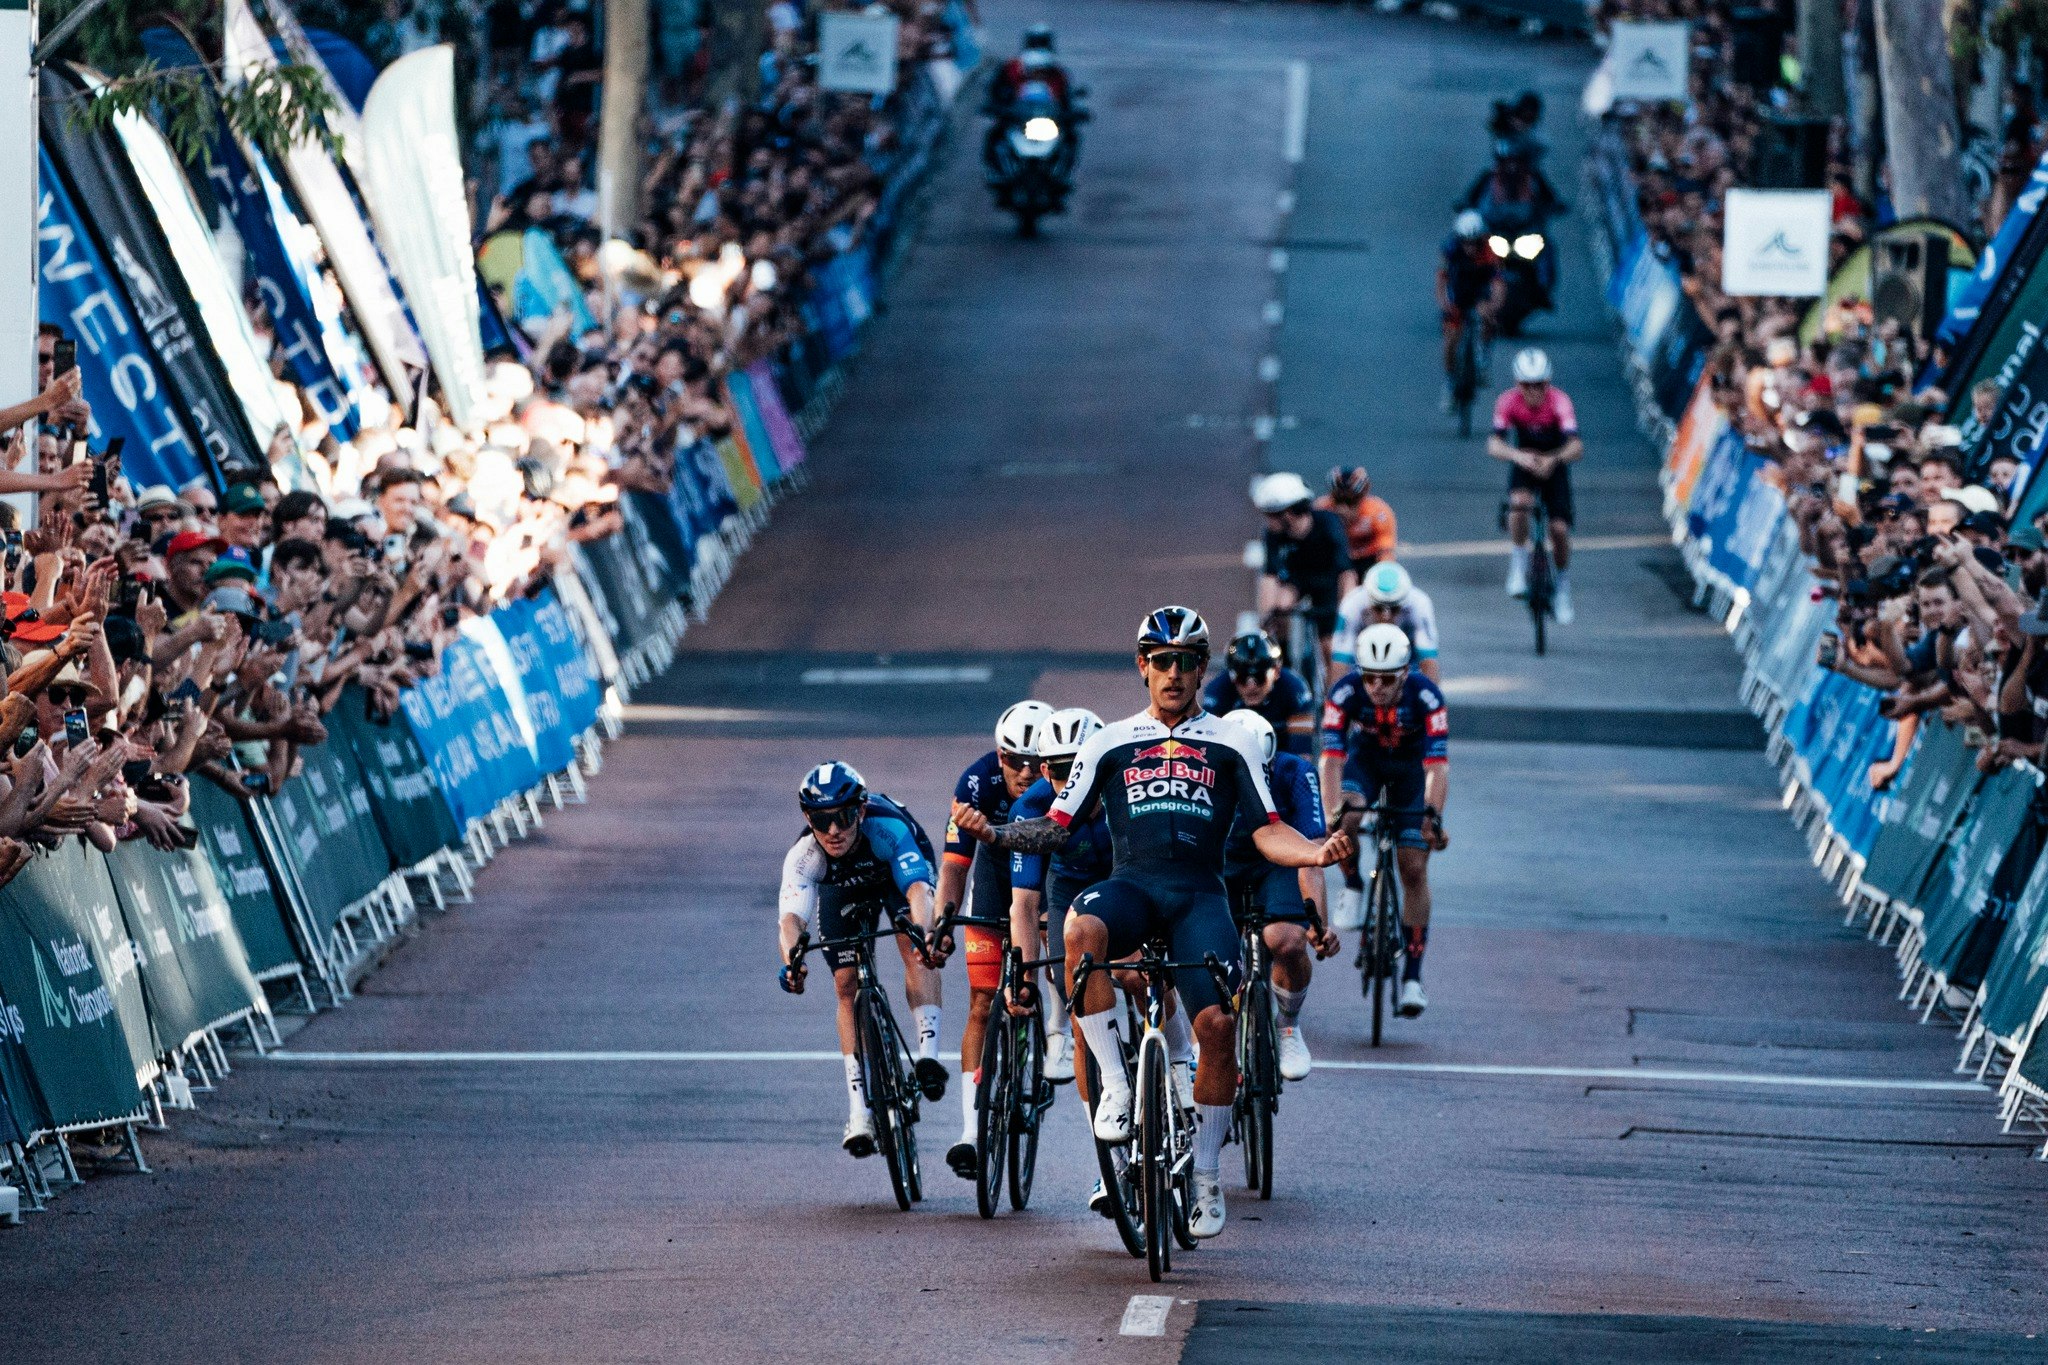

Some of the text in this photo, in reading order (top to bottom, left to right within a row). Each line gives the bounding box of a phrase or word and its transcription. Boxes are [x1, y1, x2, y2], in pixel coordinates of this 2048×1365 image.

[1058, 761, 1084, 801] BOSS
[1123, 760, 1216, 789] Red Bull
[1126, 780, 1213, 807] BORA
[1131, 801, 1211, 817] hansgrohe
